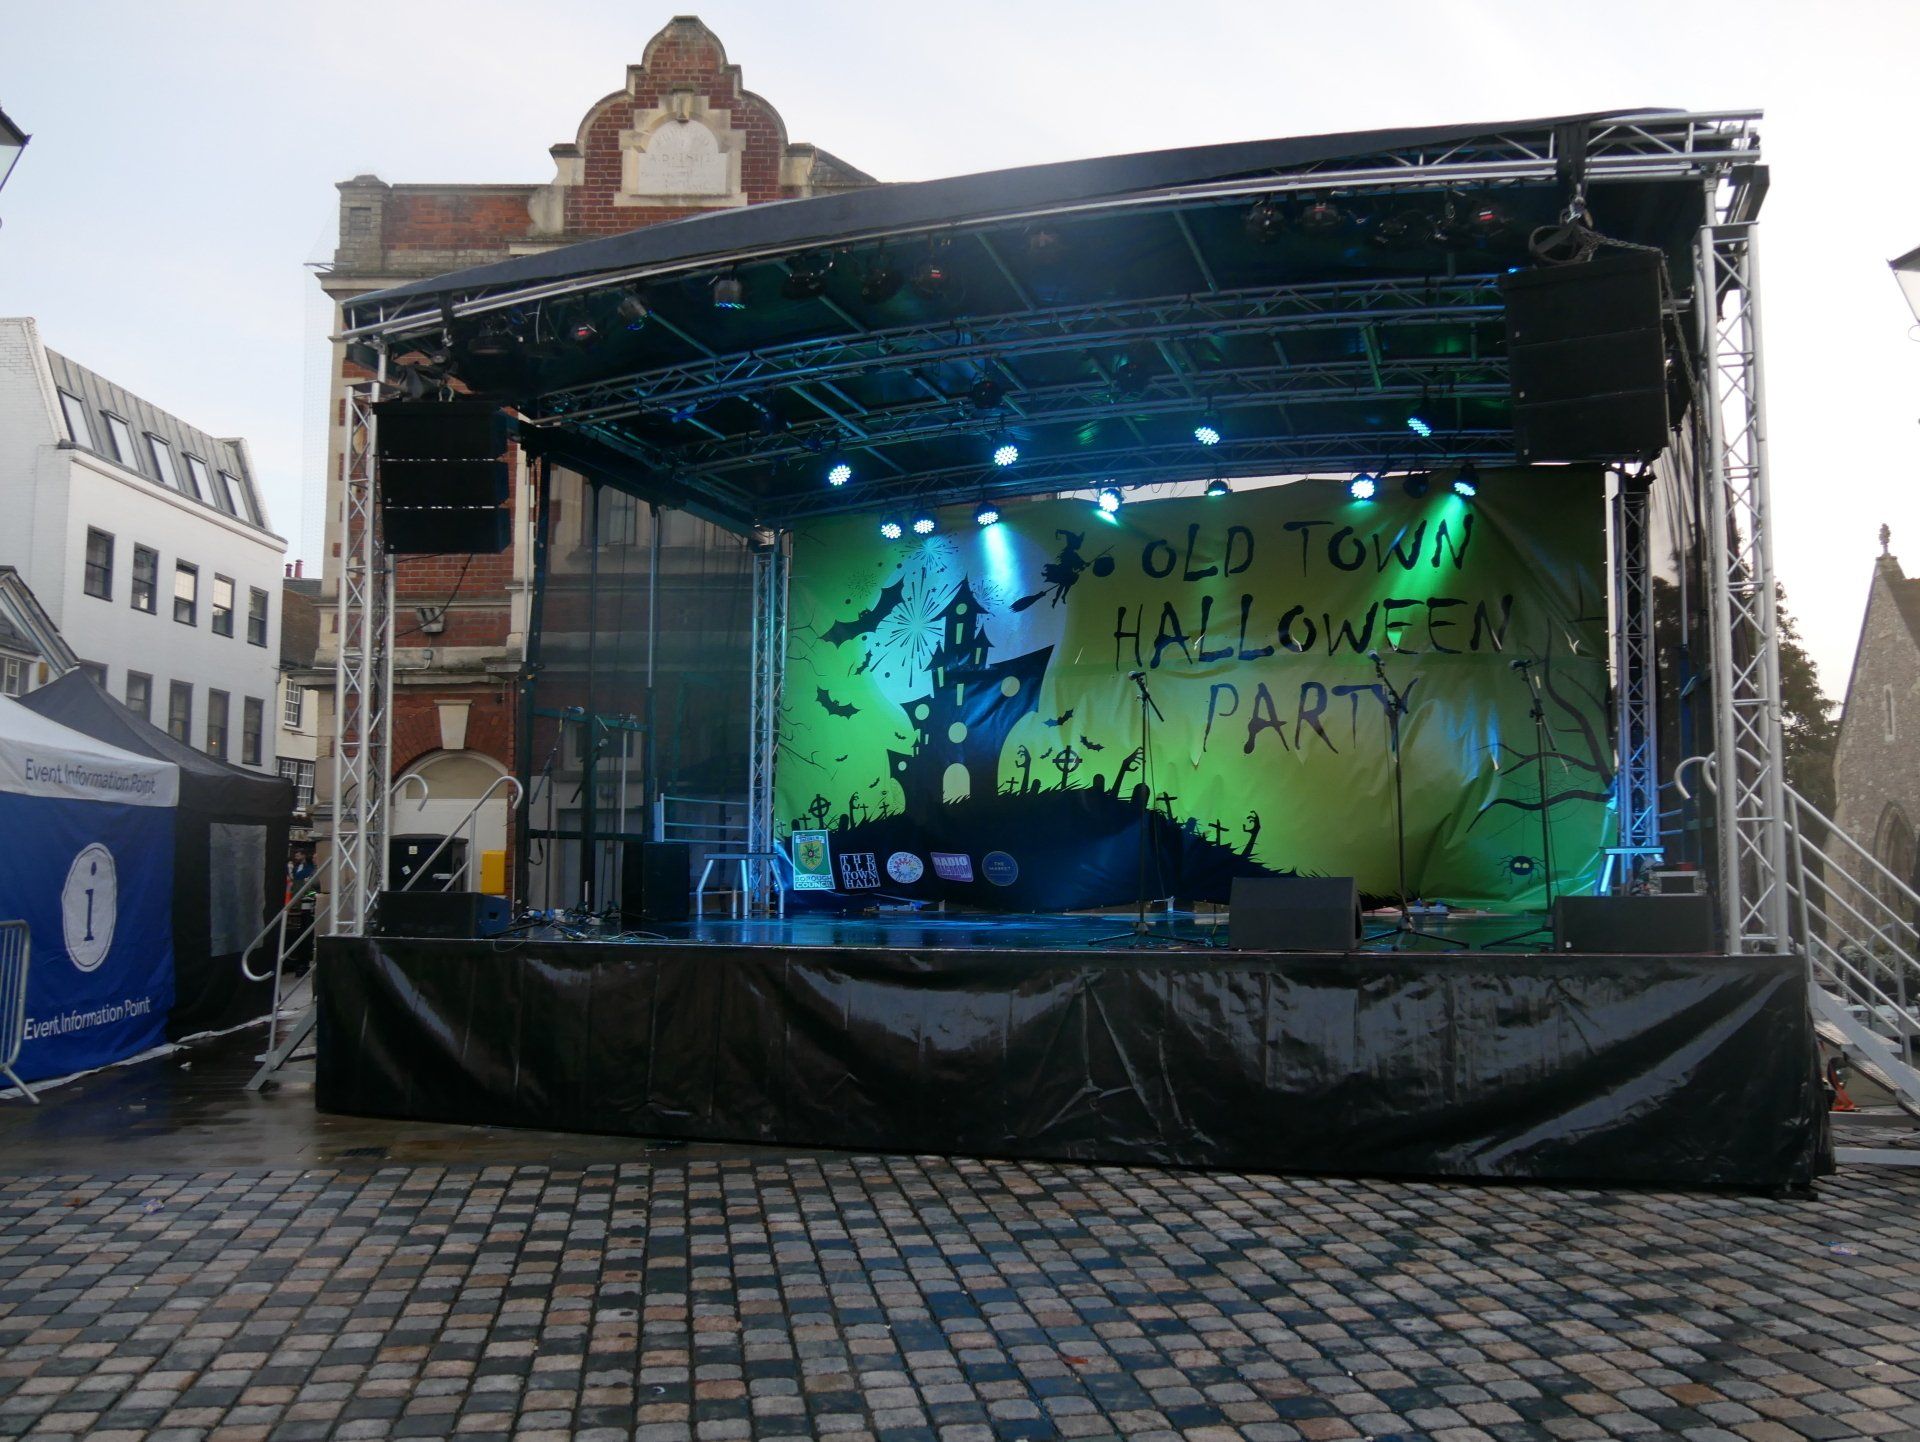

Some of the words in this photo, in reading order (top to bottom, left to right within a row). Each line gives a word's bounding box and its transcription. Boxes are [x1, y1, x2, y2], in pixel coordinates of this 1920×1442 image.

[1142, 523, 1255, 582] OLD
[1283, 513, 1474, 577] TOWN
[1113, 593, 1513, 671] HALLOWEEN
[1203, 677, 1420, 755] PARTY
[25, 758, 62, 784] Event
[66, 764, 127, 787] Information
[129, 775, 157, 795] Point
[841, 855, 874, 864] THE
[842, 863, 875, 872] OLD
[934, 856, 968, 866] RADIO
[844, 872, 877, 880] TOWN
[847, 880, 878, 888] HALL
[24, 1015, 60, 1040] Event
[61, 1005, 123, 1033] Information
[125, 996, 150, 1017] Point
